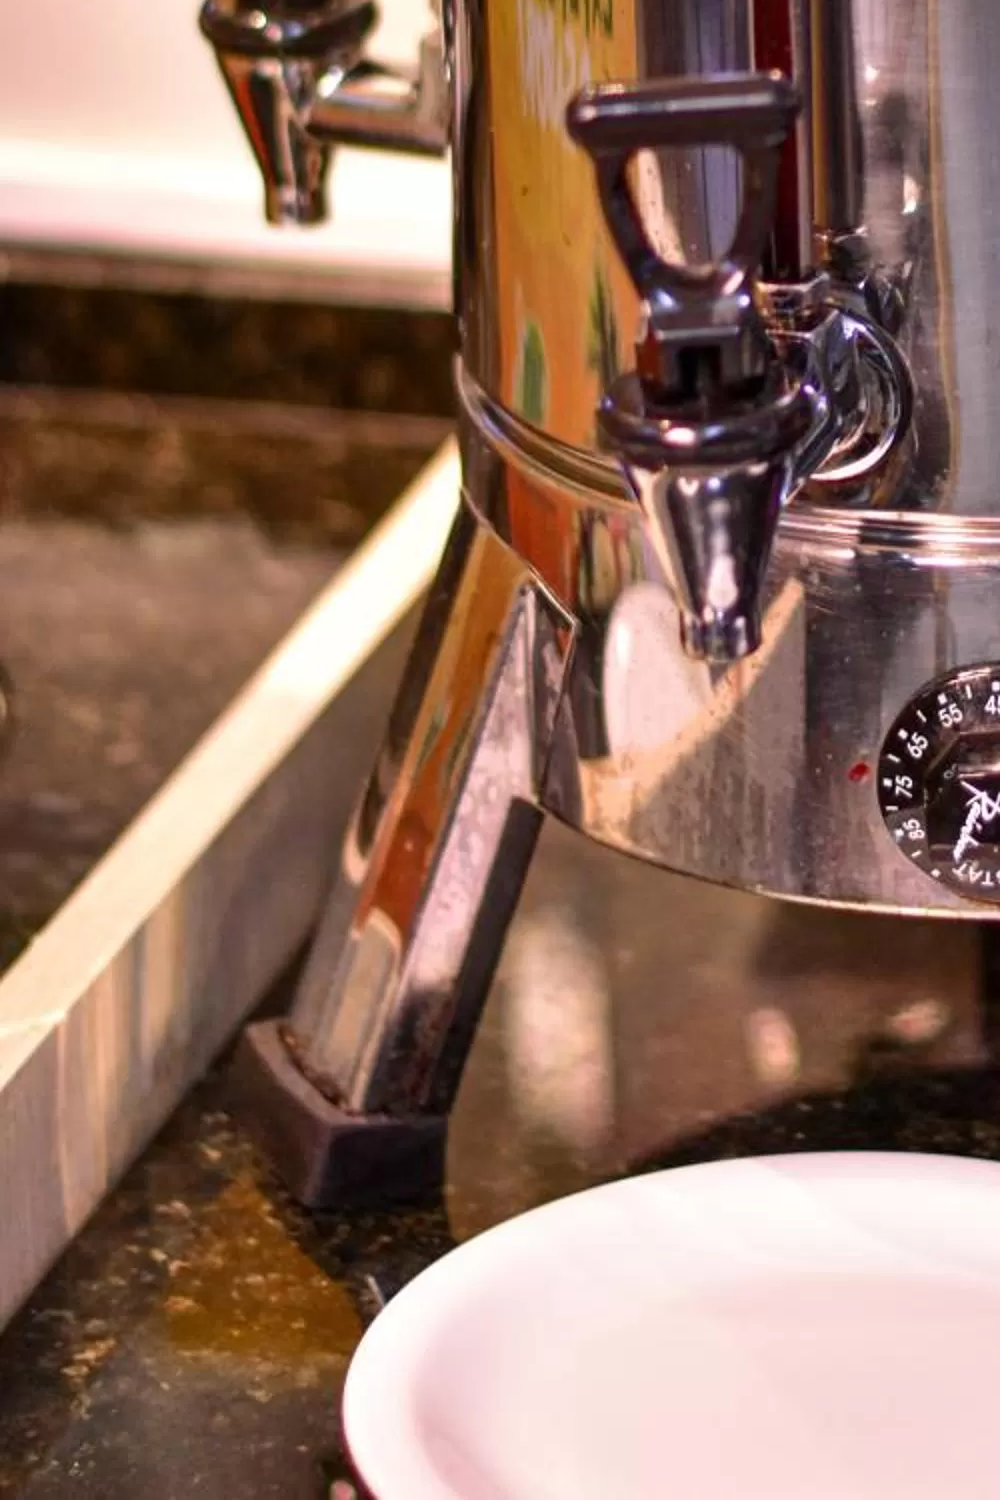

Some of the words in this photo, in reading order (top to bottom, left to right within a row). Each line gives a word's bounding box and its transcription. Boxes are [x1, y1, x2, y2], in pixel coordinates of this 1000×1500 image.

[938, 704, 964, 728] 55
[906, 733, 929, 759] 65
[895, 775, 913, 798] 75
[902, 818, 926, 841] 85
